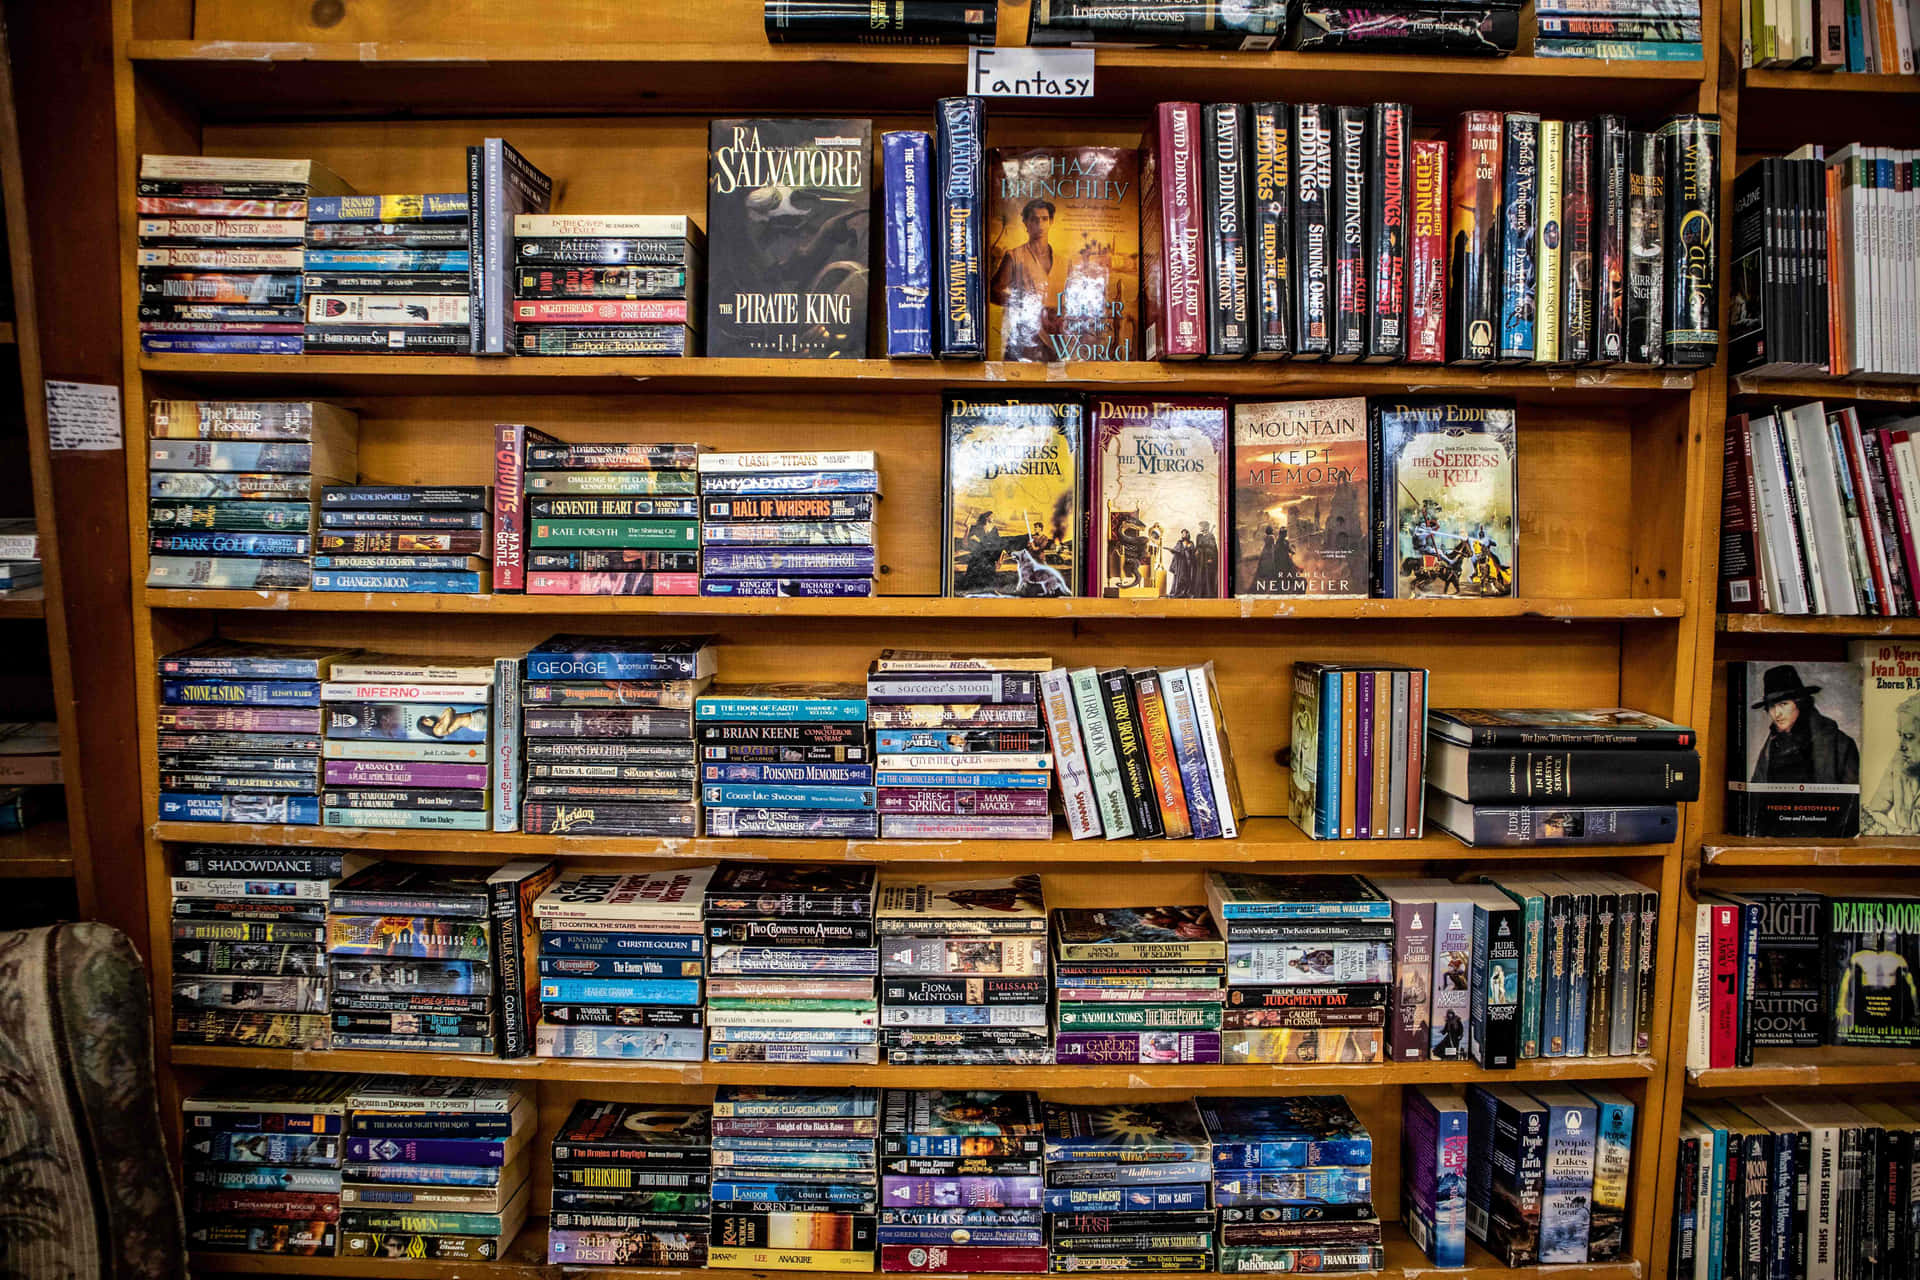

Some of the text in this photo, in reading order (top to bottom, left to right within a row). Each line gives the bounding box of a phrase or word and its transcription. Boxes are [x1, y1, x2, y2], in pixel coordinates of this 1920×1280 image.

[1131, 8, 1184, 22] FALCONES
[976, 50, 1090, 95] Fantasy
[734, 127, 766, 152] R.A.
[1472, 138, 1497, 150] DAVID
[951, 110, 971, 198] SALVATORE
[1173, 110, 1189, 206] DAVID EDDINGS
[1256, 116, 1274, 200] EDDINGS
[1274, 129, 1287, 187] DAVID
[1301, 116, 1317, 201] EDDINGS
[1316, 129, 1331, 188] DAVID
[717, 147, 862, 193] SALVATORE
[1217, 109, 1237, 232] DAVID EDDINGS
[1384, 109, 1402, 226] DAVID EDDINGS
[1476, 167, 1492, 179] COE
[1684, 144, 1696, 201] WHYTE
[1345, 120, 1364, 244] DAVID EDDINGS
[1001, 179, 1128, 201] BRENCHLEY
[1416, 153, 1432, 237] EDDINGS
[560, 241, 598, 251] FALLEN
[636, 241, 667, 251] JOHN
[554, 252, 603, 261] MASTERS
[628, 252, 675, 262] EDWARD
[950, 205, 971, 322] DEMON AWAKENS
[1183, 227, 1198, 316] DEMON LORD
[1308, 224, 1324, 316] SHINING ONES
[735, 294, 851, 324] PIRATE KING
[407, 335, 454, 345] MARK CANTER
[1472, 347, 1491, 355] TOR
[200, 407, 261, 421] The Plains
[952, 400, 1003, 417] DAVID
[1100, 402, 1147, 419] DAVID
[1287, 410, 1316, 418] THE
[1249, 418, 1356, 438] MOUNTAIN
[1136, 440, 1188, 457] KING OF
[738, 455, 770, 468] CLASH
[780, 454, 818, 466] TITANS
[1272, 449, 1333, 465] KEPT
[1413, 449, 1499, 468] THE SEERESS
[984, 460, 1061, 479] DARSHIVA
[1118, 456, 1204, 474] THE MURGOS
[1249, 467, 1359, 485] MEMORY
[1428, 469, 1482, 487] OF KELL
[555, 501, 632, 516] SEVENTH HEART
[732, 500, 830, 517] HALL OF WHISPERS
[552, 528, 618, 537] KATE FORSYTH
[171, 536, 207, 551] DARK
[496, 531, 508, 567] GENTLE
[507, 532, 519, 567] MARY
[337, 577, 409, 588] CHANGER'S MOON
[1256, 580, 1349, 591] NEUMEIER
[1879, 648, 1890, 660] 10
[537, 662, 607, 674] GEORGE
[1872, 661, 1895, 677] Ivan
[183, 688, 209, 699] STONE
[218, 687, 245, 699] STARS
[356, 687, 420, 698] INFERNO
[1294, 678, 1315, 698] NARNIA
[771, 704, 798, 712] EARTH
[1112, 693, 1138, 755] TERRY BROOKS
[1143, 696, 1168, 765] TERRY BROOKS
[723, 728, 799, 738] BRIAN KEENE
[763, 766, 848, 781] POISONED MEMORIES
[1126, 759, 1141, 798] SHANNARA
[1554, 759, 1562, 791] SERVICE
[1159, 767, 1175, 807] SHANNARA
[1536, 779, 1543, 789] IN
[908, 801, 951, 812] SPRING
[980, 802, 1015, 810] MACKEY
[550, 807, 595, 833] Meridon
[1507, 811, 1518, 836] JUDE
[1520, 805, 1530, 841] FISHER
[207, 860, 312, 872] SHADOWDANCE
[1833, 903, 1883, 932] DEATH'S
[748, 923, 853, 937] TWO CROWNS FOR AMERICA
[1446, 933, 1466, 941] JUDE
[617, 940, 688, 950] CHRISTIE GOLDEN
[1408, 946, 1425, 954] JUDE
[1441, 942, 1469, 950] FISHER
[1494, 941, 1515, 950] JUDE
[1490, 950, 1519, 958] FISHER
[921, 983, 952, 993] FIONA
[989, 981, 1040, 991] EMISSARY
[908, 991, 963, 1001] MCINTOSH
[1264, 995, 1348, 1006] JUDGMENT DAY
[1087, 1039, 1136, 1051] GARDEN
[288, 1119, 311, 1127] Arena
[1522, 1136, 1543, 1147] People
[1554, 1139, 1590, 1148] People
[1522, 1158, 1541, 1168] Earth
[1555, 1158, 1588, 1166] Lakes
[1746, 1161, 1767, 1177] MOON
[218, 1173, 277, 1185] TERRY BROOKS
[1552, 1168, 1589, 1176] Kathleen
[293, 1175, 334, 1185] SHANNARA
[735, 1190, 768, 1200] LANDOR
[1818, 1148, 1831, 1264] JAMES HERBERT SHRINE
[901, 1213, 963, 1224] CAT HOUSE
[660, 1241, 690, 1250] ROBIN
[576, 1249, 631, 1261] DESTINY
[660, 1251, 688, 1261] HOBB
[1237, 1257, 1285, 1271] Dahomean
